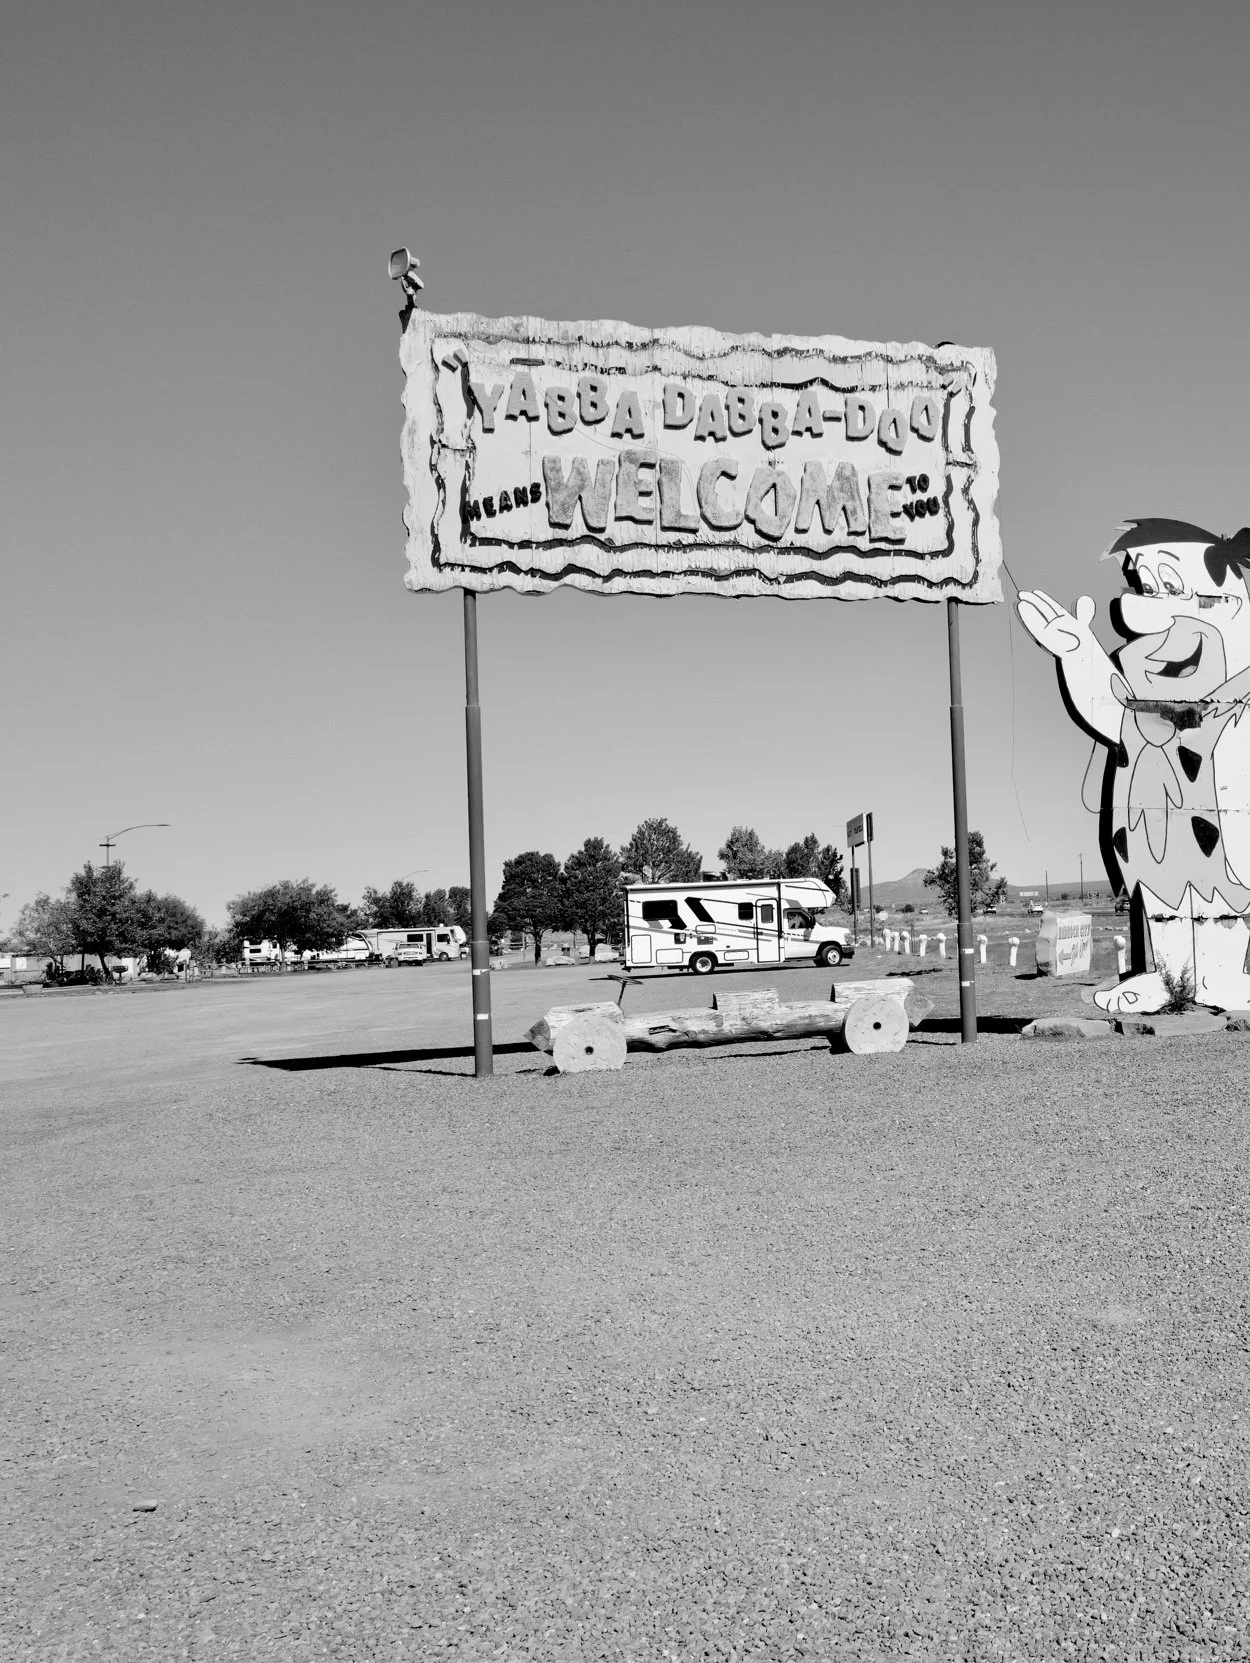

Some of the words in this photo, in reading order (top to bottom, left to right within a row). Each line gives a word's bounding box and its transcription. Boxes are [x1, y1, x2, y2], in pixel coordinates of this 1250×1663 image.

[470, 371, 645, 440] YABBA
[466, 482, 541, 521] MEANS
[542, 450, 906, 545] WELCOME
[905, 473, 930, 495] TO
[902, 496, 940, 522] YOU
